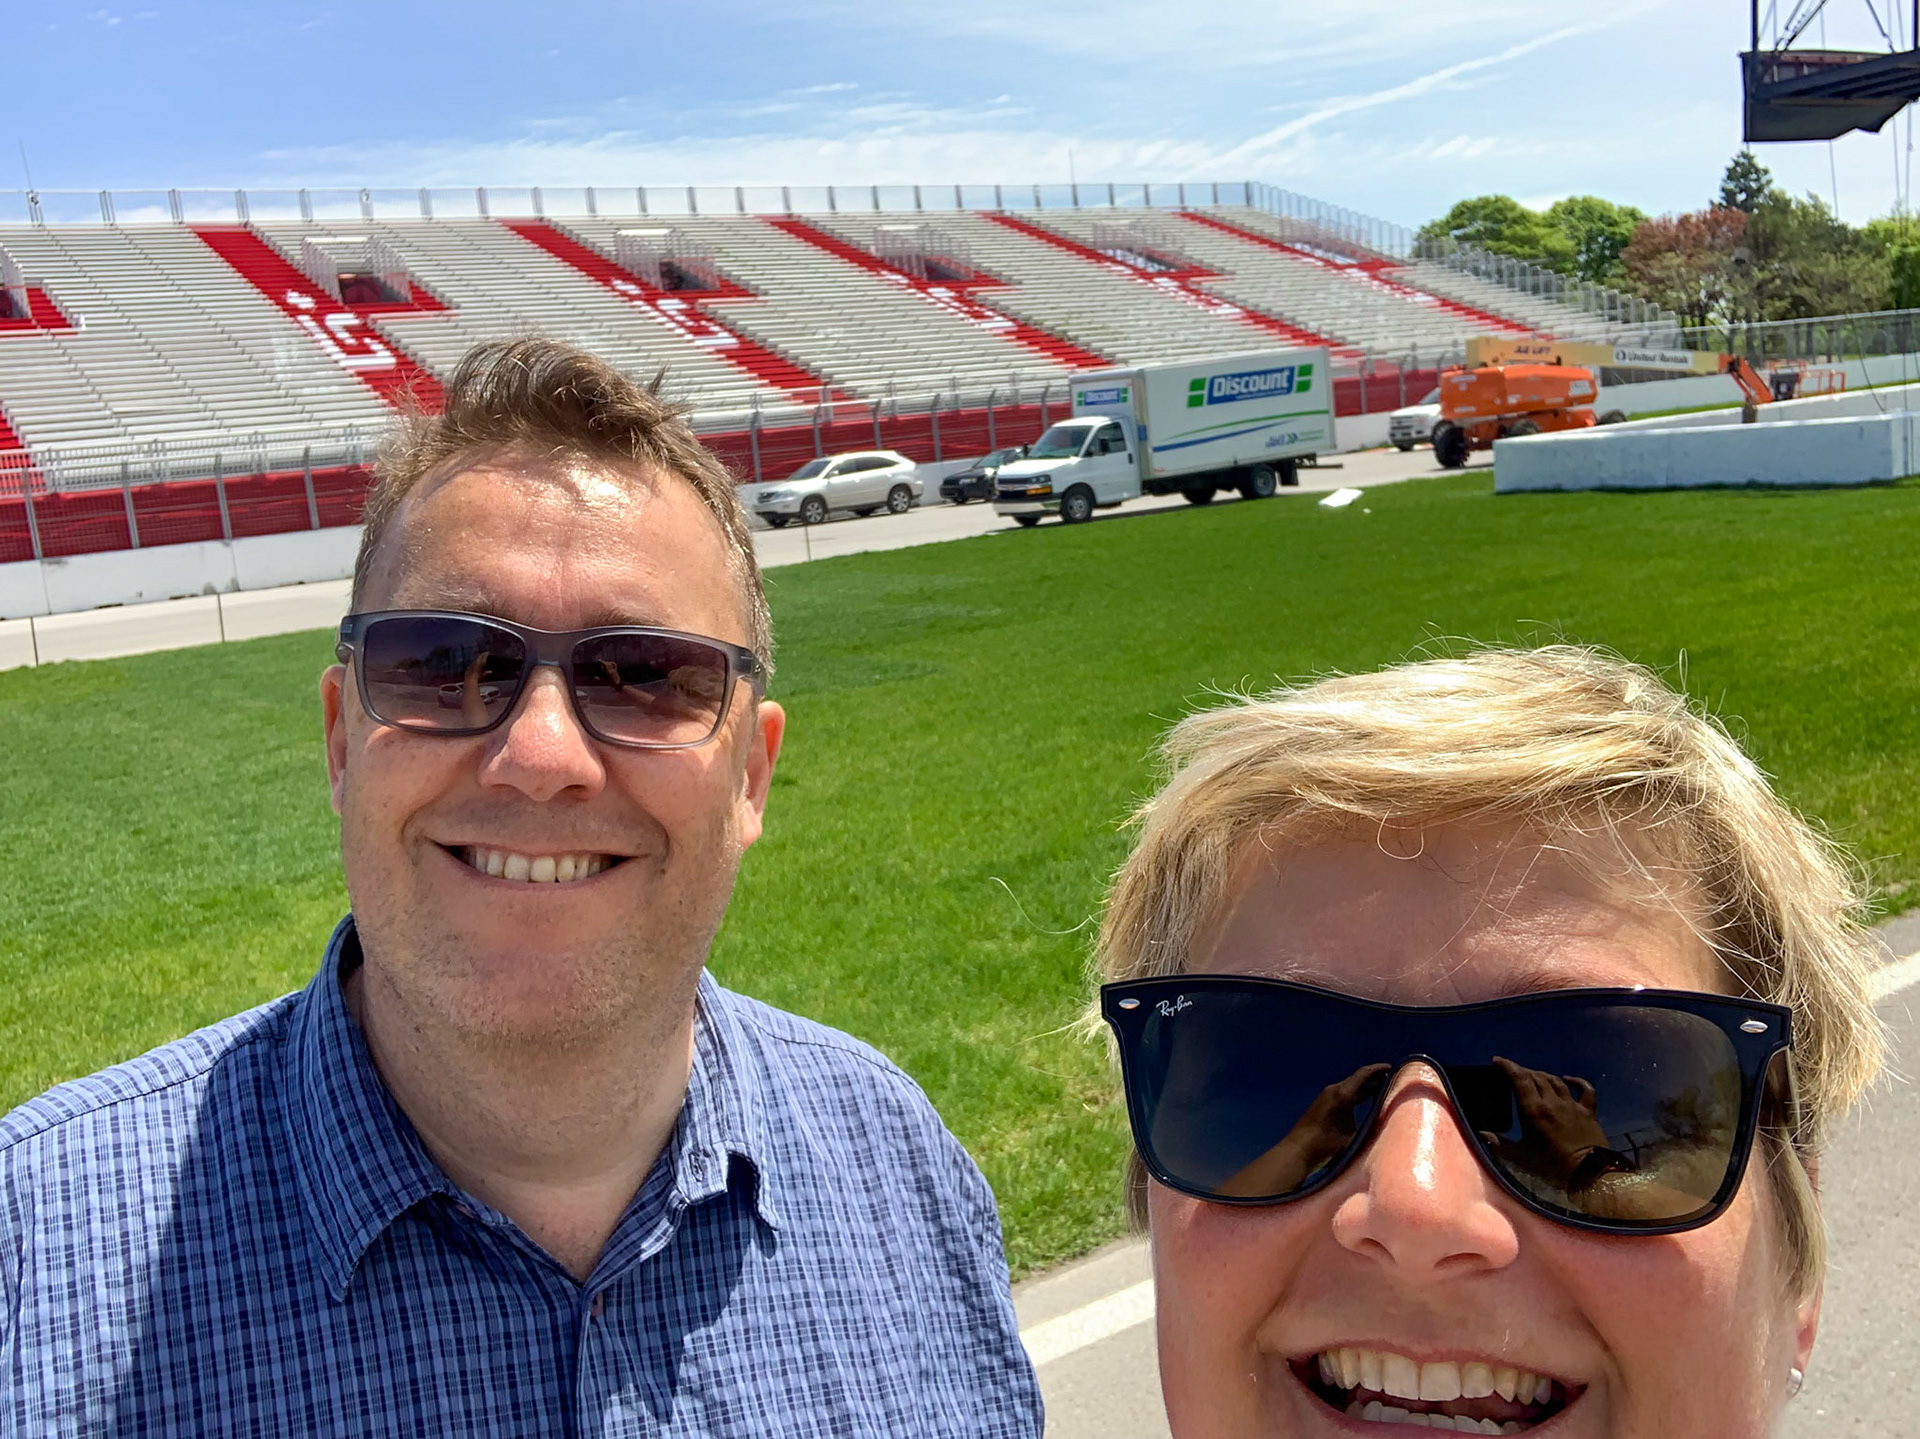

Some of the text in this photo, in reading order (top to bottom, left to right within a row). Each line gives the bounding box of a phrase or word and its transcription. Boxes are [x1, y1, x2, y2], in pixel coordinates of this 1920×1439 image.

[1628, 351, 1655, 362] United
[1211, 368, 1290, 398] Discount
[1085, 389, 1117, 402] Discount
